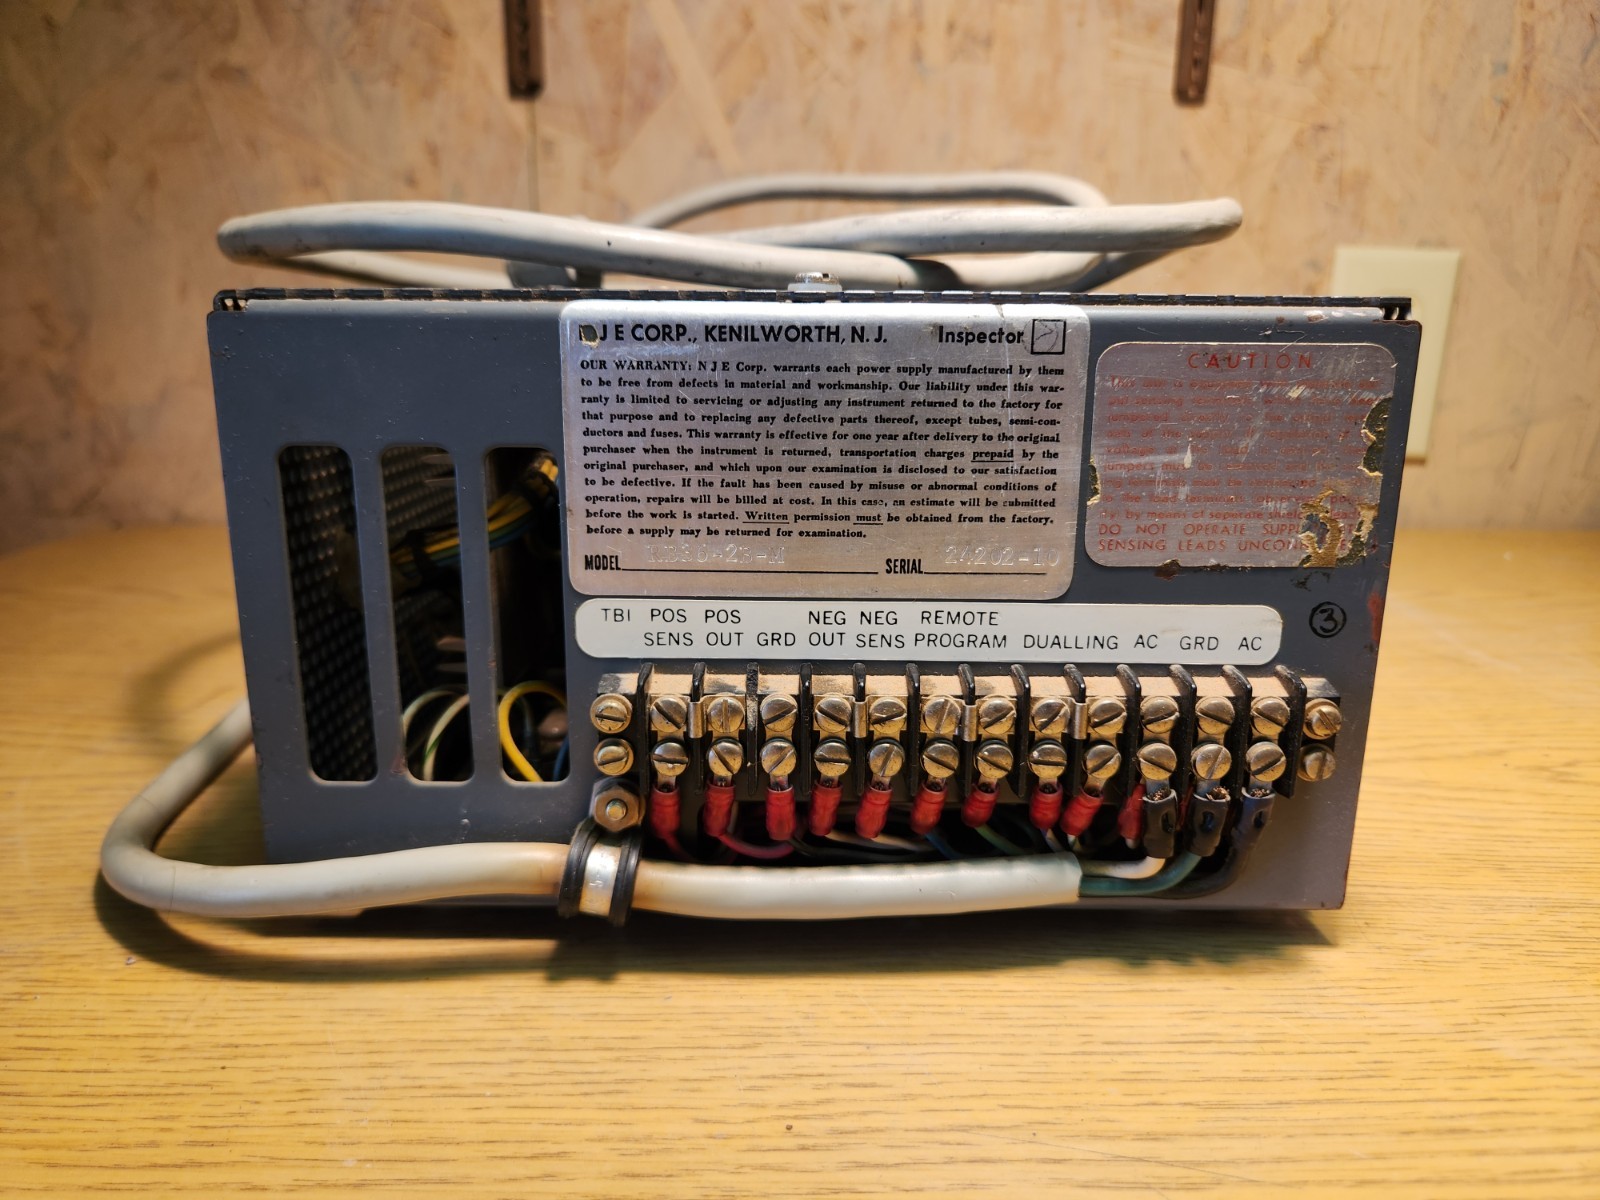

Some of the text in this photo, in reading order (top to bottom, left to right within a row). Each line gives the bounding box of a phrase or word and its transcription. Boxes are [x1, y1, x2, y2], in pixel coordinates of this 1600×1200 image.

[615, 325, 624, 341] E
[631, 324, 697, 343] CORP.,
[705, 325, 846, 344] KENILWORTH,
[851, 326, 870, 343] N.
[874, 326, 888, 343] J.
[938, 326, 1024, 346] Inspector
[580, 360, 1064, 376] OUR WARRANTY: Corp. warrants each power supply manufactured them
[1188, 352, 1311, 369] CAUTION
[618, 377, 640, 387] free
[647, 378, 673, 387] from
[679, 378, 718, 388] defects
[741, 380, 786, 389] material
[792, 380, 811, 389] and
[818, 381, 892, 393] workmanship.
[899, 381, 920, 391] Our
[926, 382, 971, 393] liability
[977, 382, 1008, 391] under
[1014, 382, 1034, 392] this
[581, 394, 1063, 411] ranty limited servicing adjusting any instrument returned the factory for
[582, 411, 1060, 427] that purpose and replacing any defective parts thereof, except tubes, semi-con-
[583, 428, 623, 437] ductors
[628, 428, 646, 437] and
[651, 428, 682, 438] fuses.
[686, 429, 710, 438] This
[714, 431, 762, 441] warranty
[779, 430, 828, 440] effective
[832, 431, 849, 440] for
[876, 434, 899, 443] year
[902, 432, 930, 440] after
[934, 432, 978, 443] delivery
[998, 432, 1014, 441] the
[1017, 433, 1060, 444] original
[583, 445, 1059, 460] purchaser when the instrument returned, transportation charges prepaid the
[584, 461, 626, 472] original
[633, 461, 688, 472] purchaser,
[695, 462, 713, 471] and
[720, 463, 750, 472] which
[756, 466, 782, 475] upon
[812, 465, 877, 473] examination
[898, 465, 948, 474] disclosed
[995, 466, 1057, 475] satisfaction
[621, 477, 1038, 491] defective. the fault has been caused misuse abnormal conditions
[585, 494, 640, 504] operation,
[647, 495, 684, 505] repairs
[690, 495, 711, 503] will
[736, 495, 766, 504] billed
[790, 497, 814, 505] cost.
[838, 497, 856, 505] this
[910, 498, 954, 506] estimate
[960, 498, 980, 506] will
[1003, 498, 1056, 507] submitted
[586, 509, 622, 518] before
[628, 510, 644, 518] the
[650, 510, 677, 519] work
[698, 511, 738, 520] started.
[745, 511, 788, 520] Written
[794, 513, 850, 523] permission
[906, 514, 952, 522] obtained
[958, 514, 983, 523] from
[990, 514, 1006, 523] the
[1012, 514, 1054, 525] factory.
[586, 525, 866, 538] before supply may returned for examination.
[1099, 523, 1121, 535] DO
[1136, 523, 1167, 535] NOT
[1183, 523, 1246, 535] OPERATE
[1099, 539, 1167, 551] SENSING
[1178, 540, 1227, 551] LEADS
[585, 555, 621, 571] MODEL
[886, 558, 923, 575] SERIAL
[650, 608, 687, 623] POS
[705, 609, 741, 624] POS
[808, 610, 846, 625] NEG
[860, 611, 898, 625] NEG
[921, 610, 999, 626] REMOTE
[643, 632, 1262, 651] SENS OUT GRD OUT SENS PROGRAM DUALLING AC GRD AC
